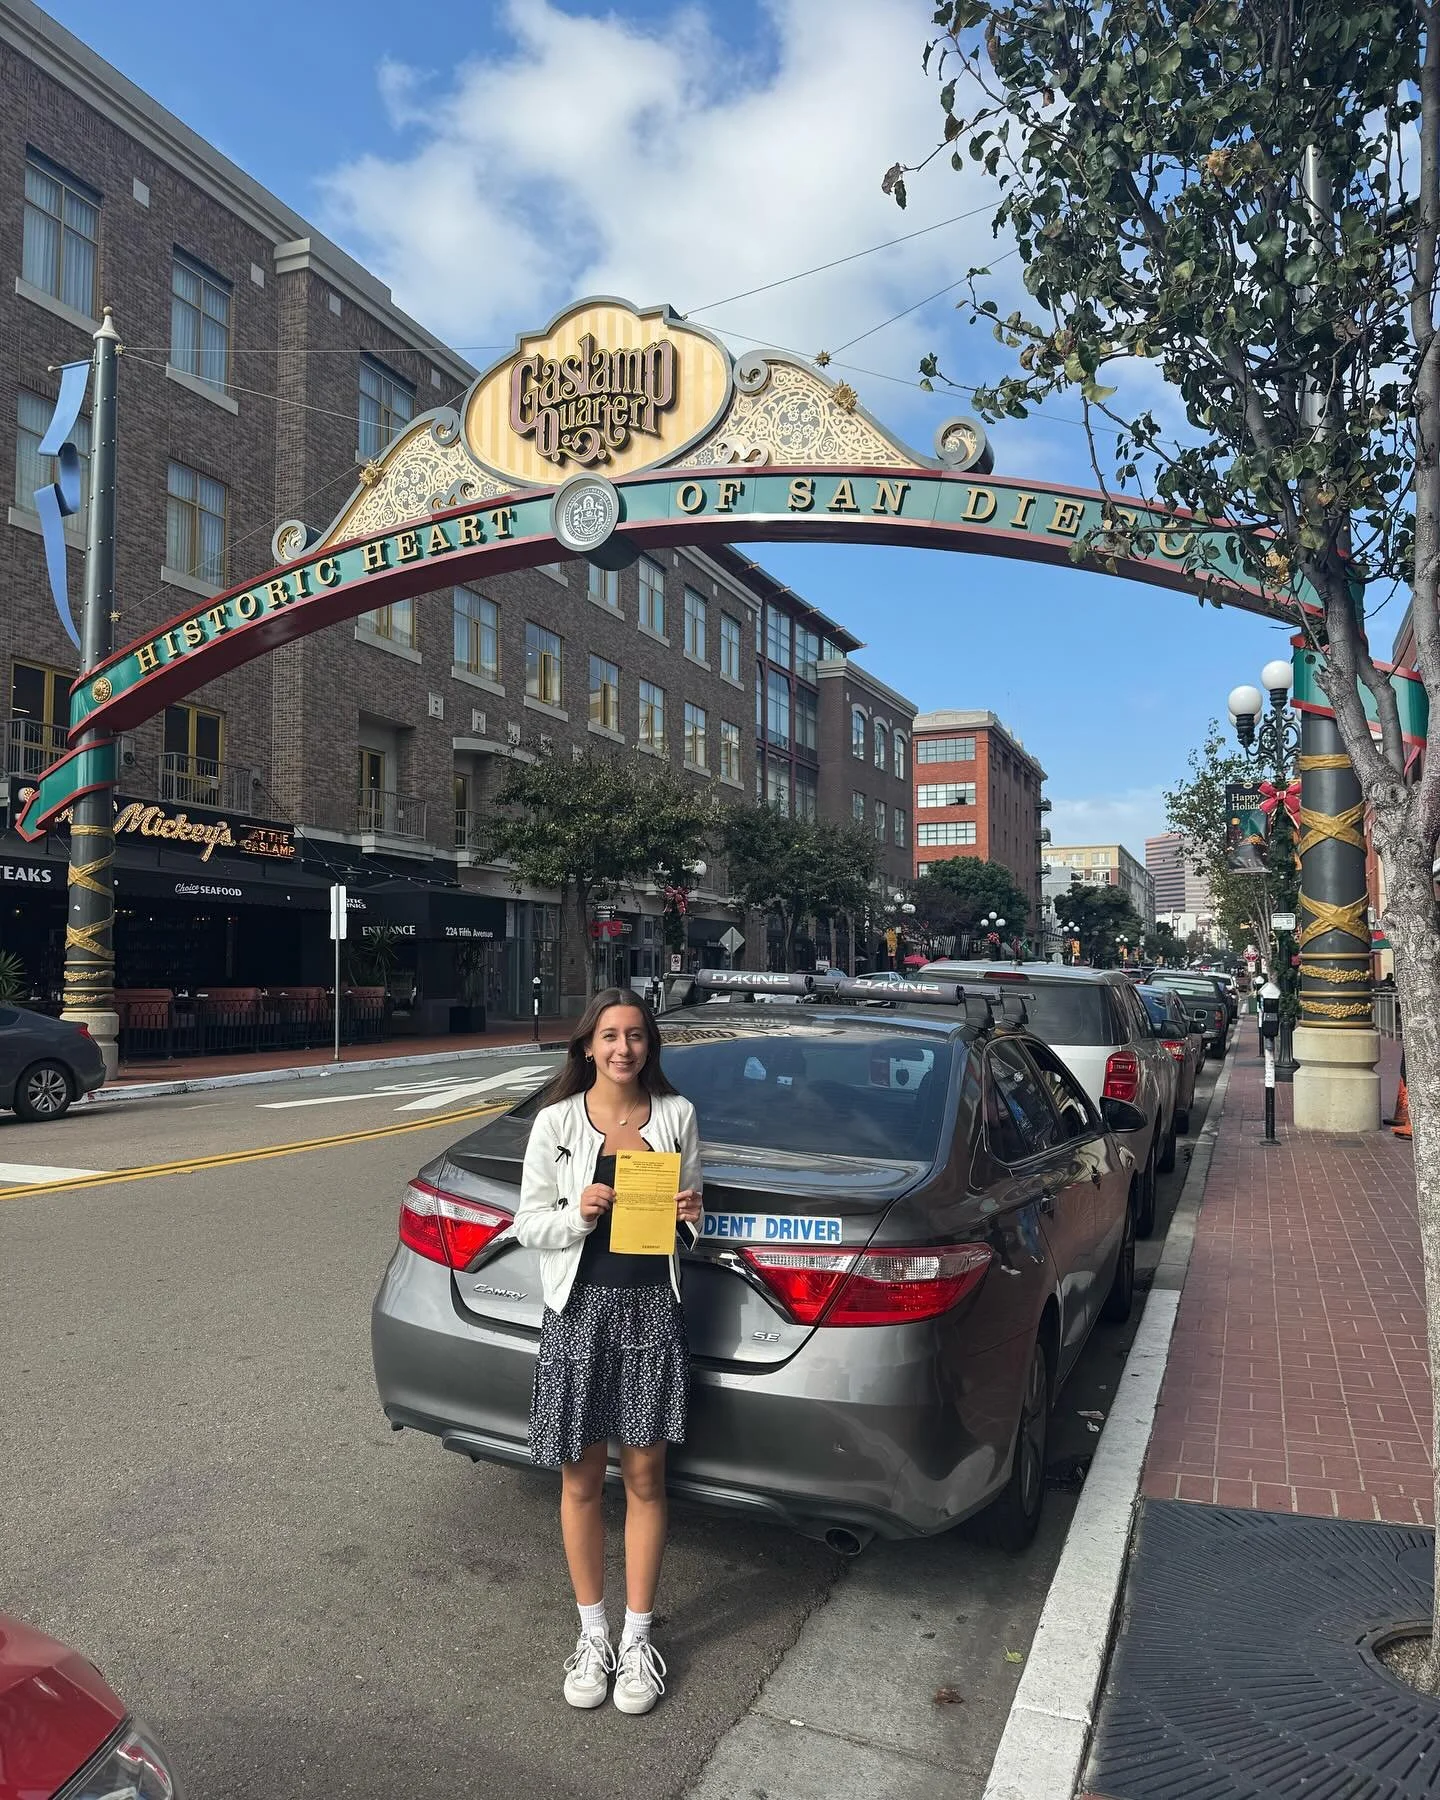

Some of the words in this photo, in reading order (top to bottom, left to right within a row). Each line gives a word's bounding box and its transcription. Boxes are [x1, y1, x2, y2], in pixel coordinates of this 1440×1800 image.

[510, 332, 676, 435] Gaslamp
[535, 393, 647, 465] Quarter
[134, 557, 338, 675] HISTORIC
[361, 507, 514, 572] HEART
[676, 480, 743, 512] OF
[787, 478, 910, 514] SAN
[1231, 793, 1260, 802] Happy
[1232, 802, 1260, 810] Holida
[113, 802, 236, 862] Mickey's
[251, 829, 268, 841] AT
[269, 832, 289, 844] THE
[244, 840, 297, 857] GASLAMP
[174, 883, 200, 895] Choice
[200, 885, 242, 897] SEAFOOD
[445, 927, 458, 937] 224
[459, 927, 472, 937] Fifth
[473, 929, 494, 939] Avenue
[711, 973, 791, 985] DAKINE
[852, 979, 942, 994] DAKINE
[765, 1218, 840, 1241] DRIVER
[473, 1284, 529, 1302] CAMRY
[752, 1331, 780, 1342] SE
